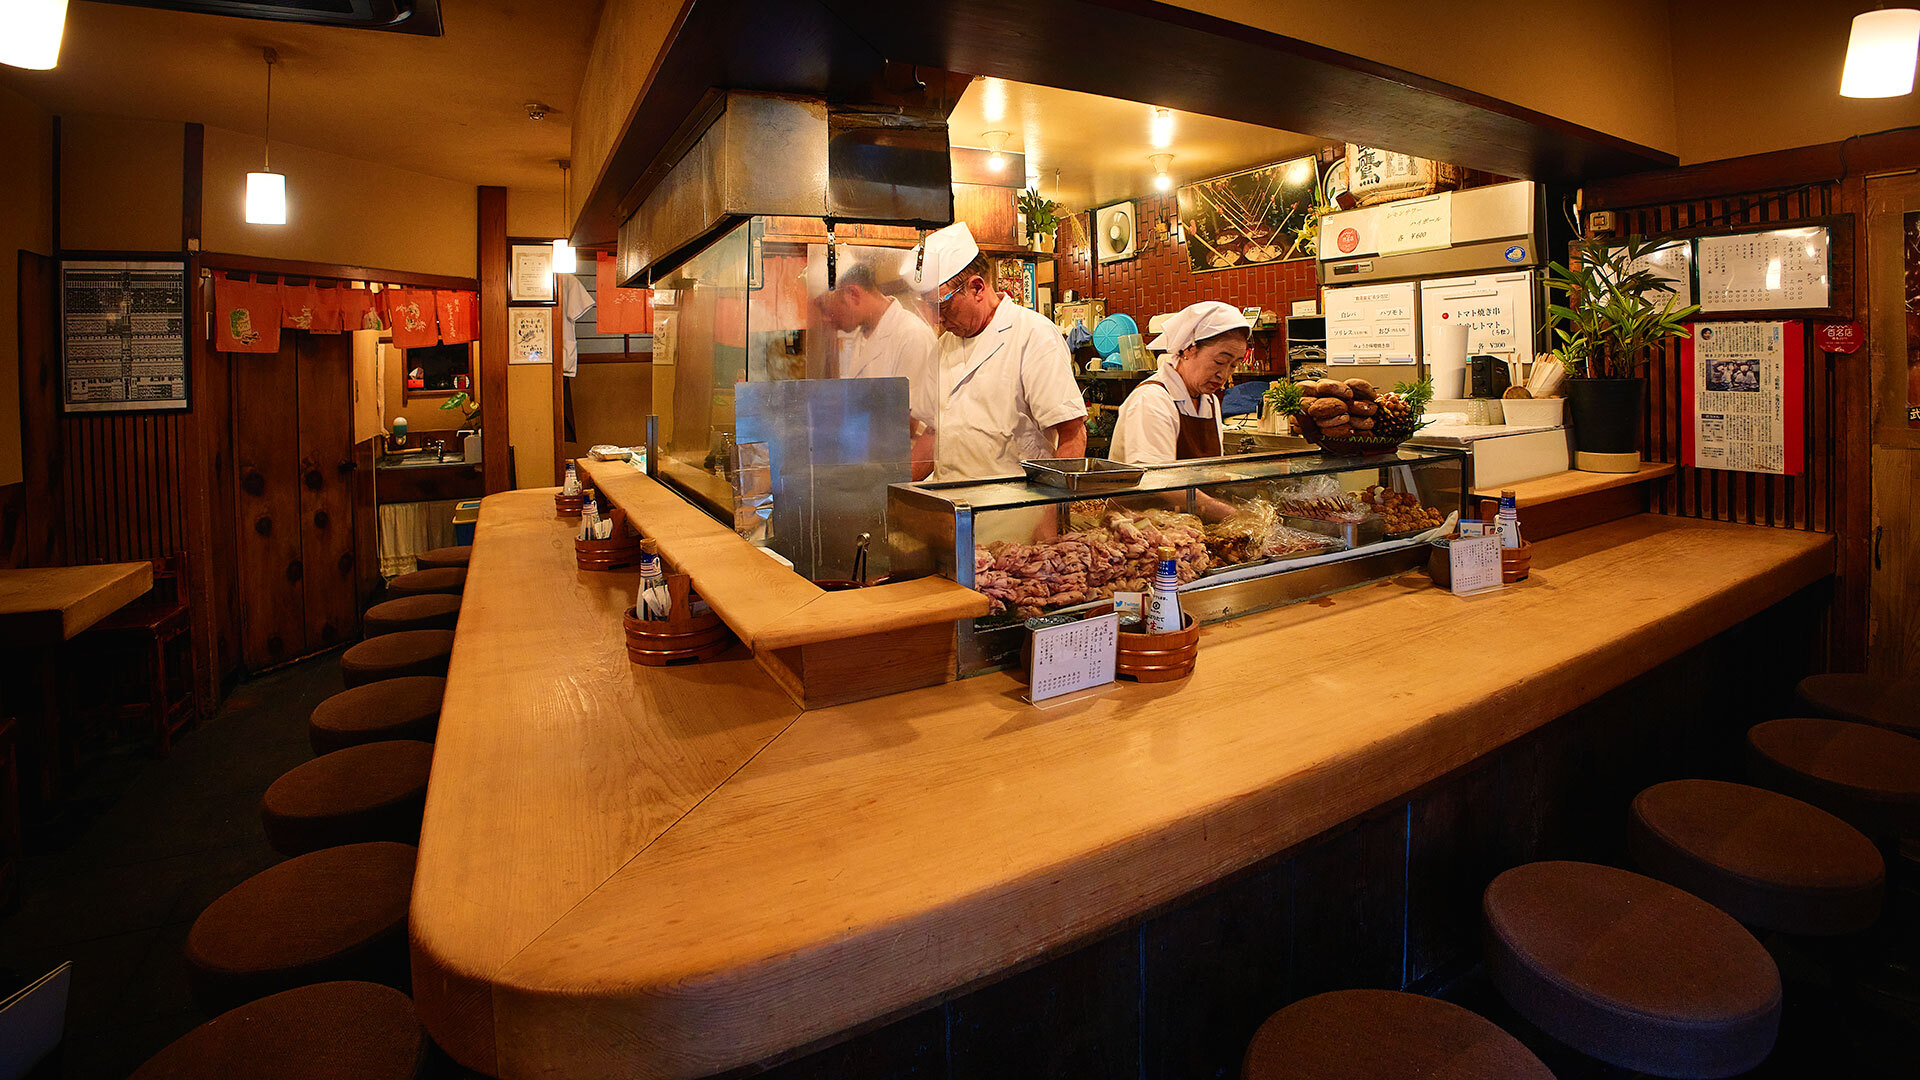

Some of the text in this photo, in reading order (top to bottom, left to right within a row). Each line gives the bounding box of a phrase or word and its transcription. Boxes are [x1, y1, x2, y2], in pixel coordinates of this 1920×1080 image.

[1380, 308, 1403, 316] ハツモト
[1827, 328, 1853, 337] 百名店
